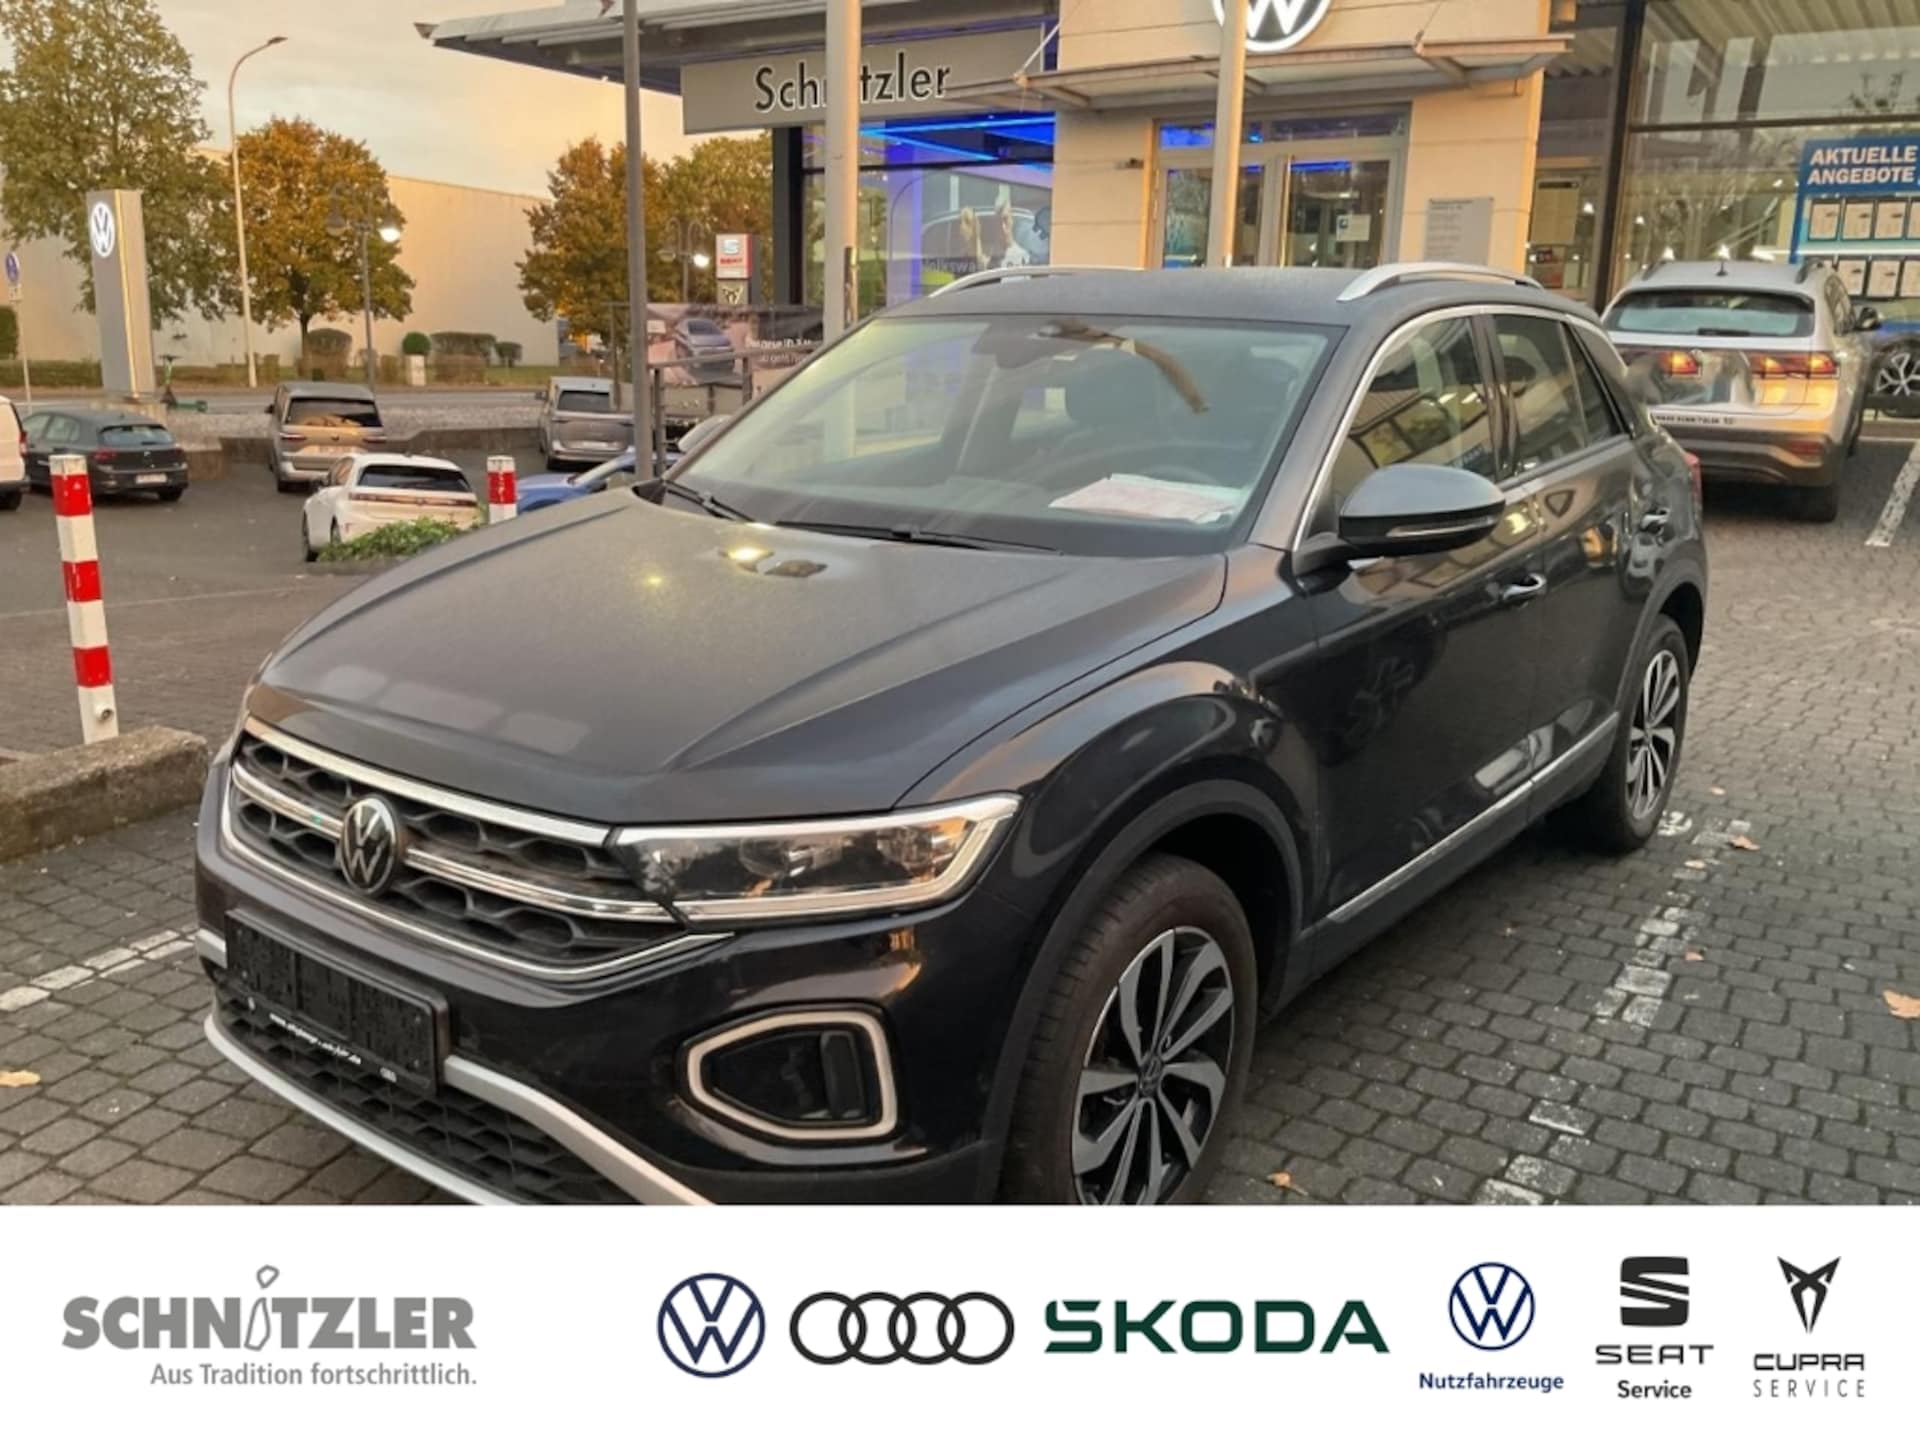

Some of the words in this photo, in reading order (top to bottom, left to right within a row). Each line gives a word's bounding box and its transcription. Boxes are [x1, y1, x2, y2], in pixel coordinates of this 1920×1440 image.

[755, 50, 950, 111] Schtzler
[1810, 145, 1918, 165] AKTUELLE
[1807, 166, 1916, 185] ANGEBOTE
